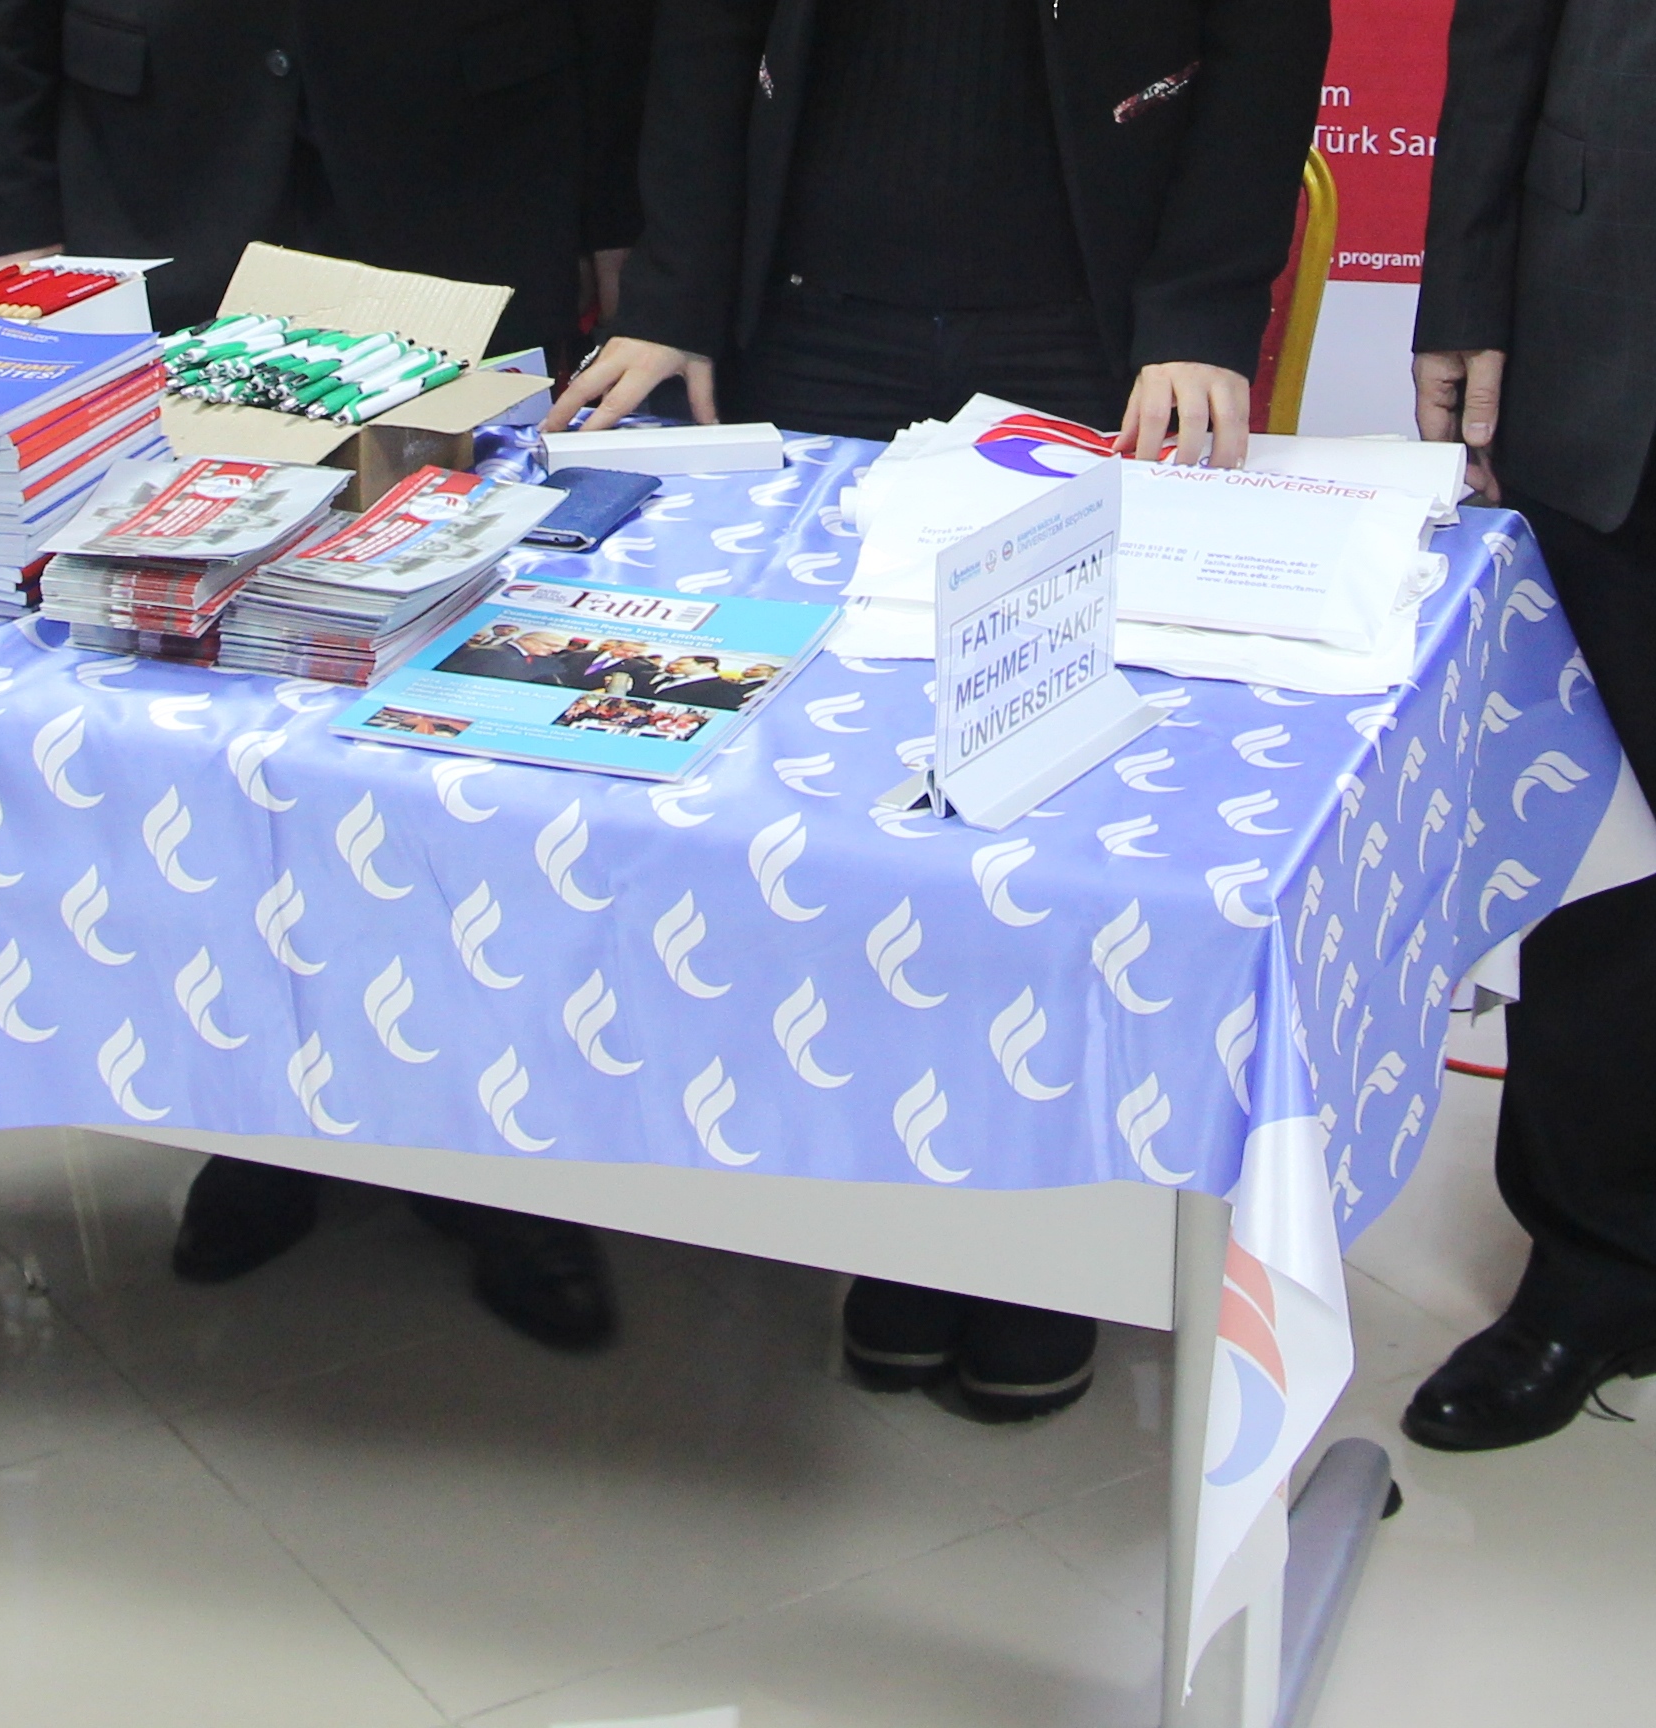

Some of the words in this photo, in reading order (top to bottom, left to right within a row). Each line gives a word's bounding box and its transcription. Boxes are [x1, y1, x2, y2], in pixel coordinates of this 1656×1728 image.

[1149, 468, 1221, 482] VAKIF
[1224, 474, 1377, 500] ÜNİVERSİTESİ
[568, 590, 673, 621] Fatih
[956, 633, 1043, 713] MEHMET
[1048, 596, 1105, 654] VAKIF
[961, 598, 1020, 659] FATİH
[1026, 549, 1103, 618] SULTAN
[960, 642, 1095, 758] ÜNİVERSİTESİ
